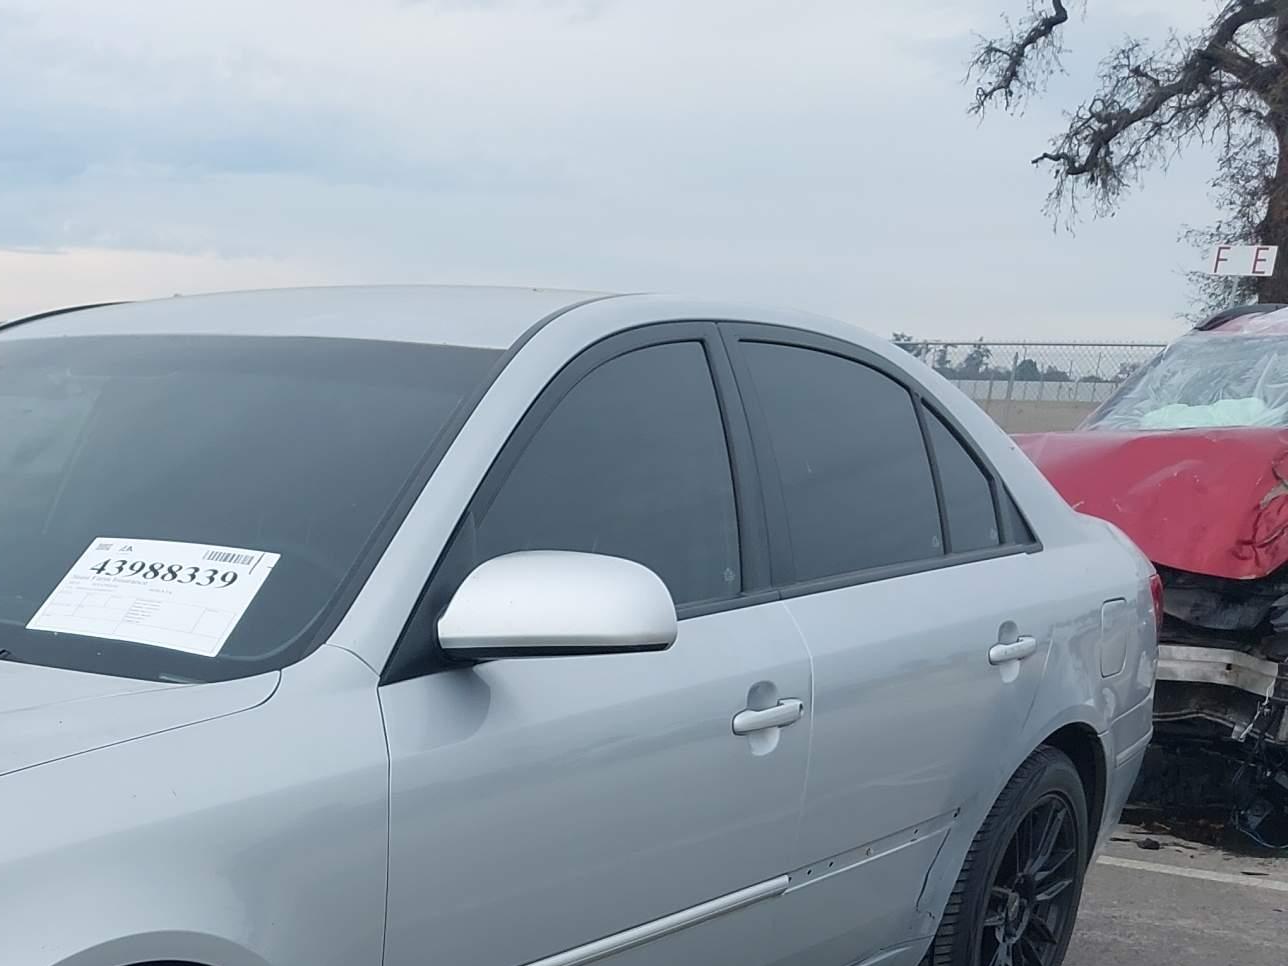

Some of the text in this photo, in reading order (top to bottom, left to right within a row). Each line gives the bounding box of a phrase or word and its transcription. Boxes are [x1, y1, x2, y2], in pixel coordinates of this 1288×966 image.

[1214, 246, 1269, 274] F E
[89, 558, 238, 588] 43988339
